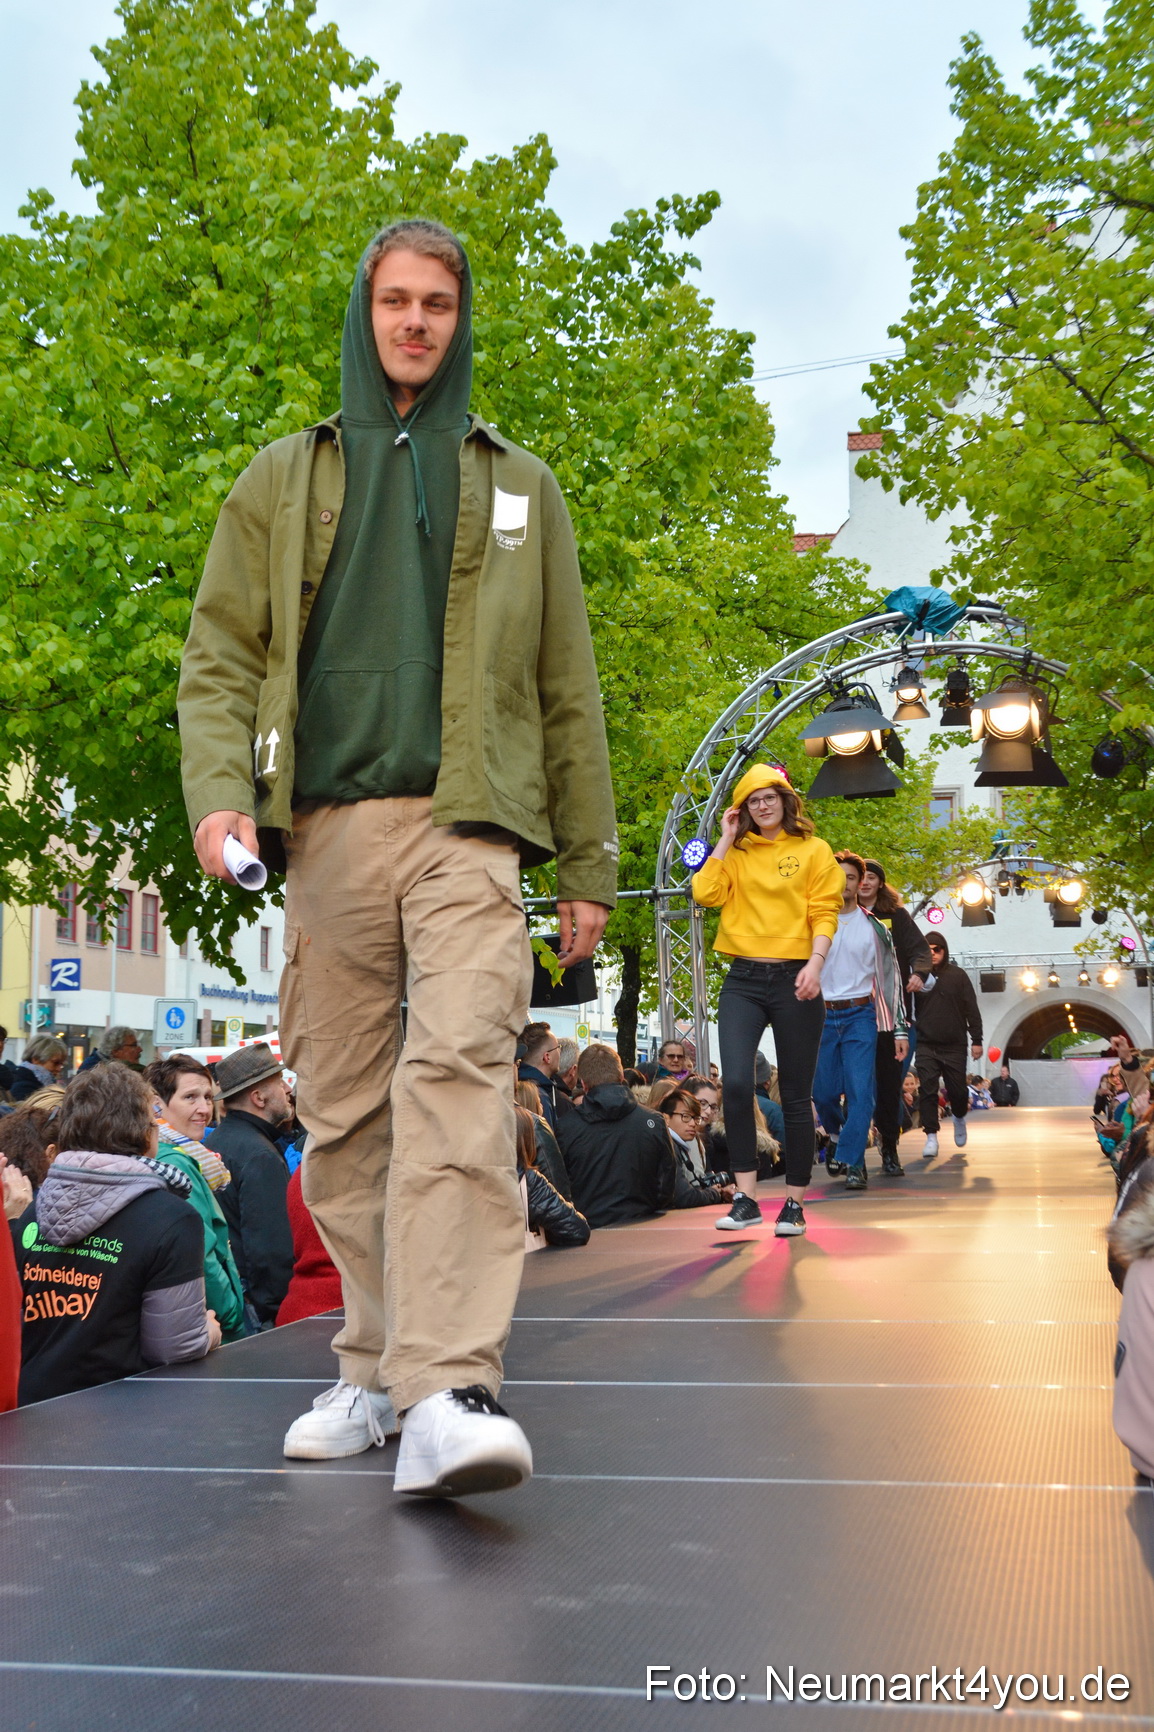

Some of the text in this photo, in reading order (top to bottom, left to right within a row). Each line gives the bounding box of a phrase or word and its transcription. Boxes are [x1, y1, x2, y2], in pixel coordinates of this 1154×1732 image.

[251, 989, 279, 1005] Rupprech
[164, 1033, 185, 1041] ZONE
[76, 1248, 89, 1257] von
[89, 1248, 119, 1264] Wäsche
[23, 1289, 99, 1323] Bilbay
